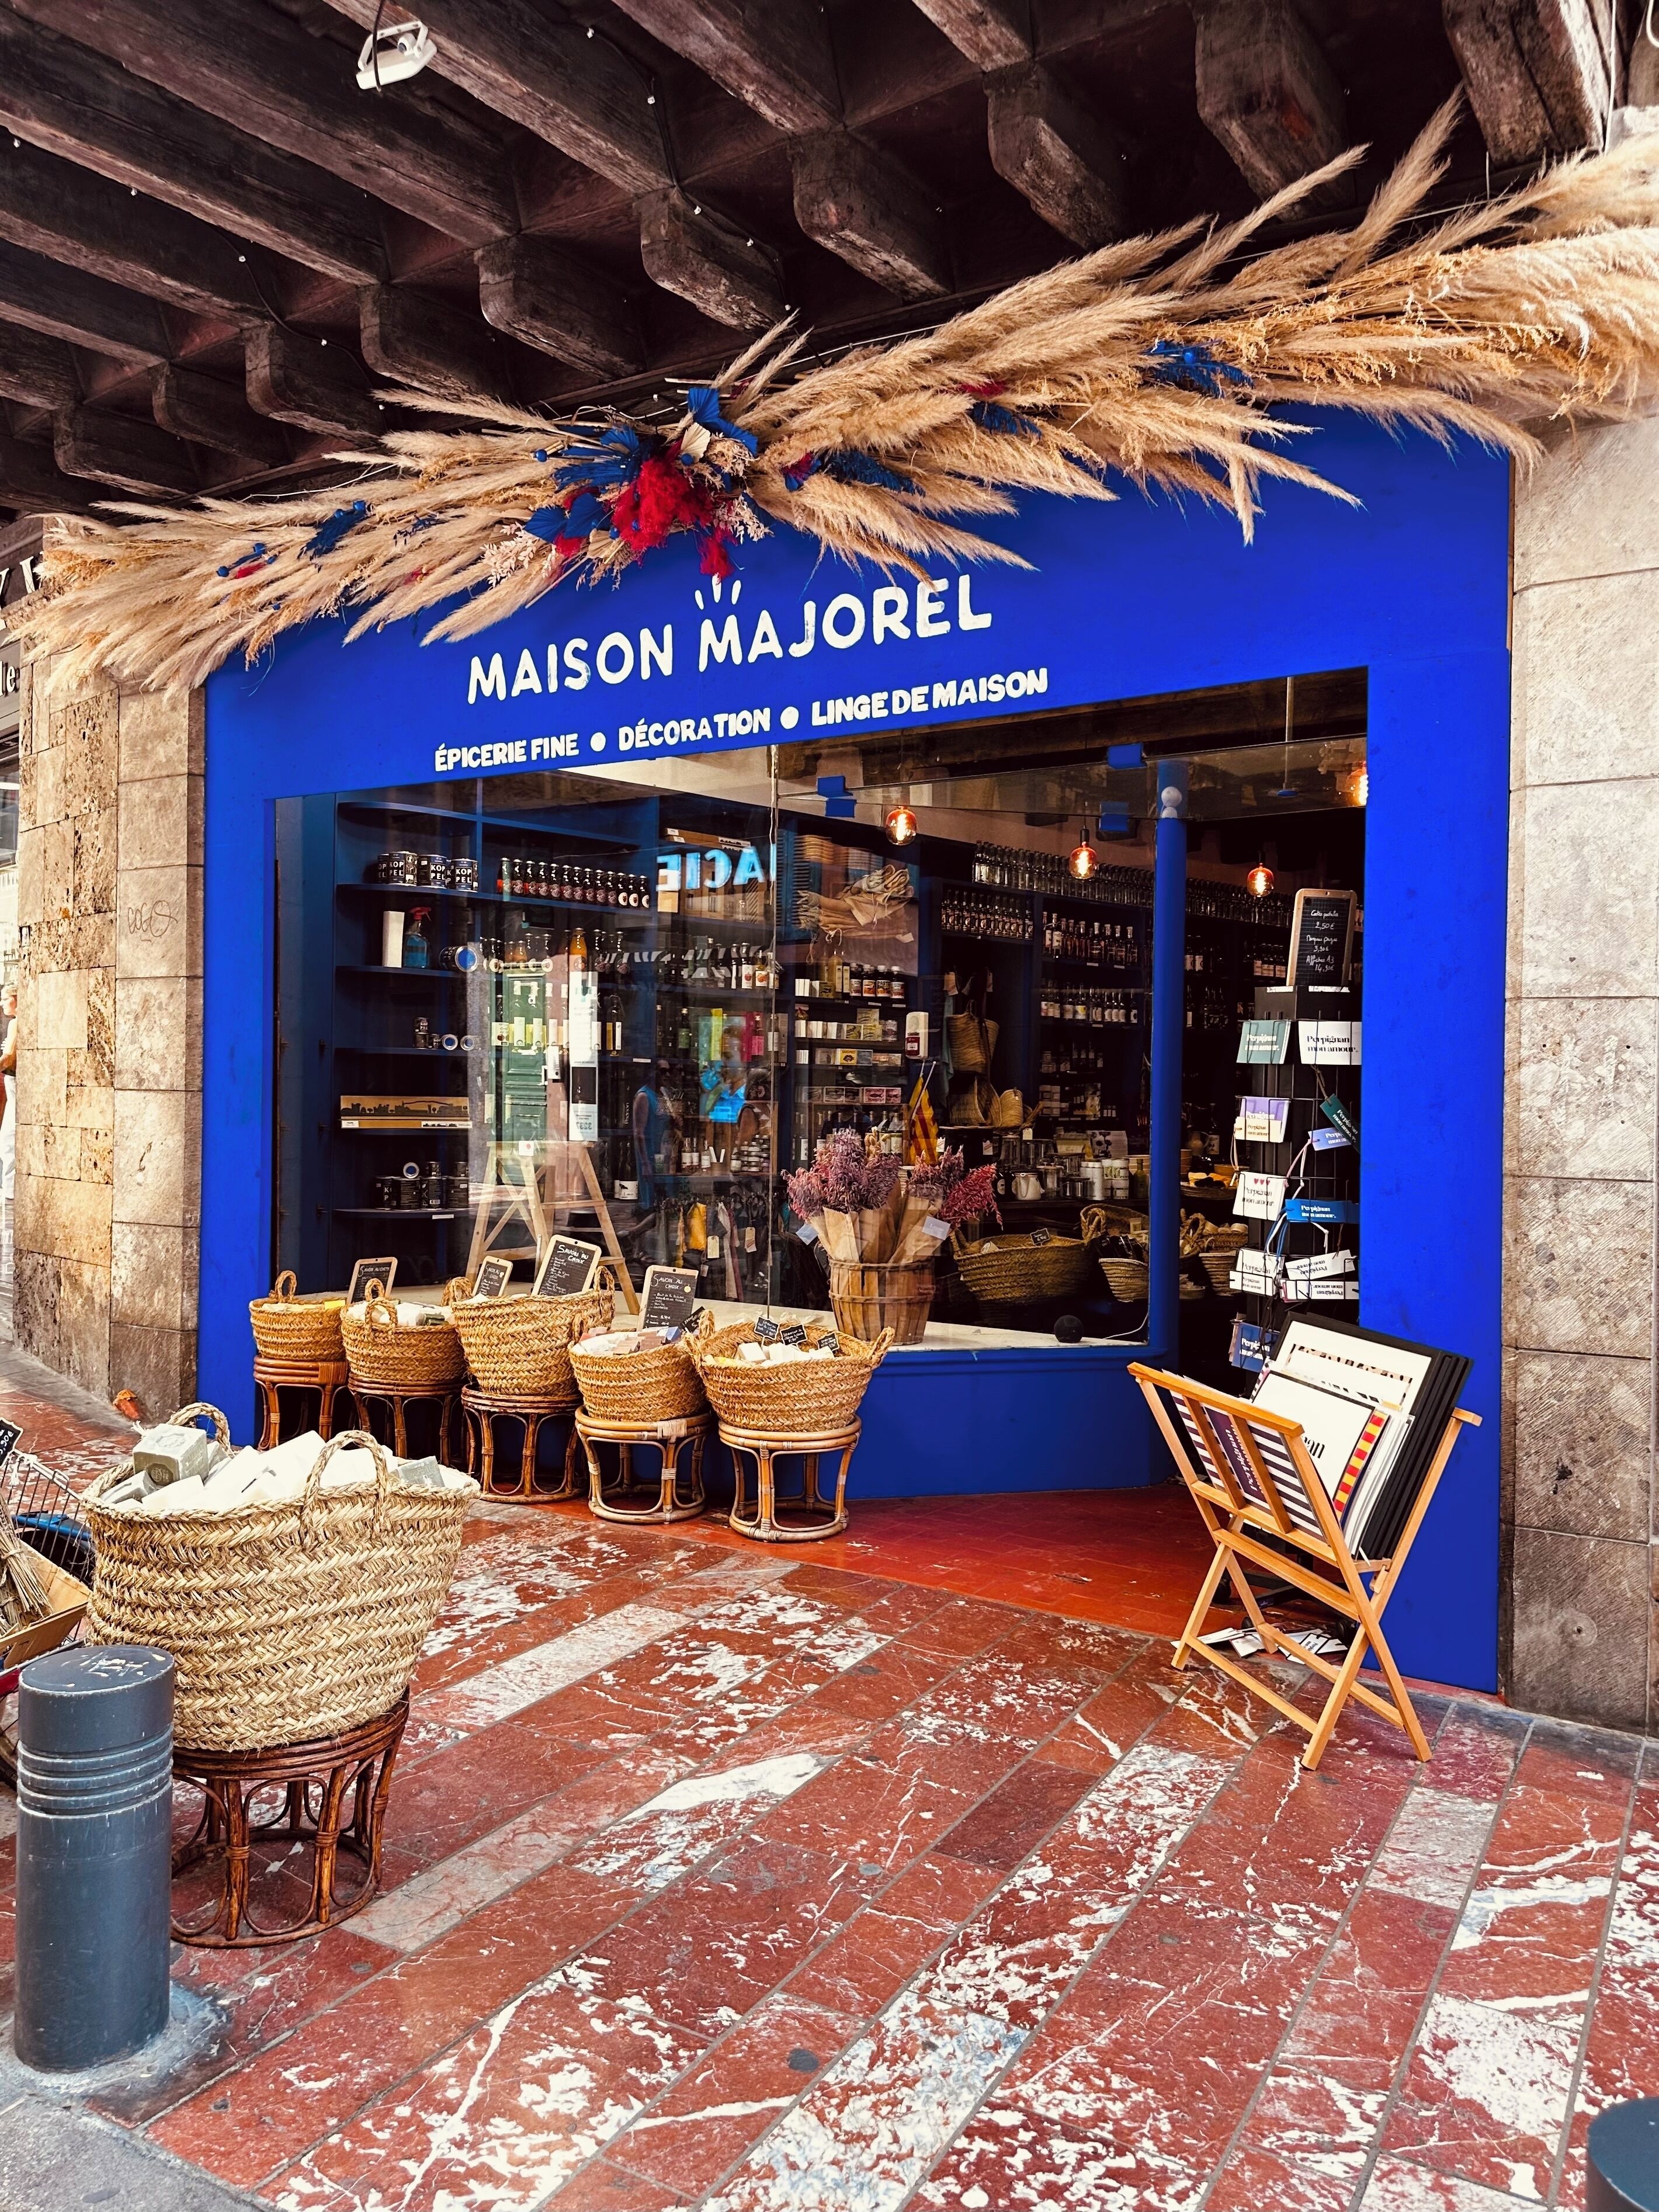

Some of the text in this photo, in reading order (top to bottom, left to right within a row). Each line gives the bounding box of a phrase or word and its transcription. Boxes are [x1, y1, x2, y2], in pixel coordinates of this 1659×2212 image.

[467, 574, 992, 704] MAISON MAJOREL
[435, 668, 1048, 772] ÉPICERIE FINE DÉCORATION LINGE DE MAISON
[1247, 1033, 1277, 1043] Perpignan
[1307, 1035, 1350, 1044] Perpignan
[557, 1245, 579, 1256] SAVON
[650, 1274, 673, 1287] SAVON
